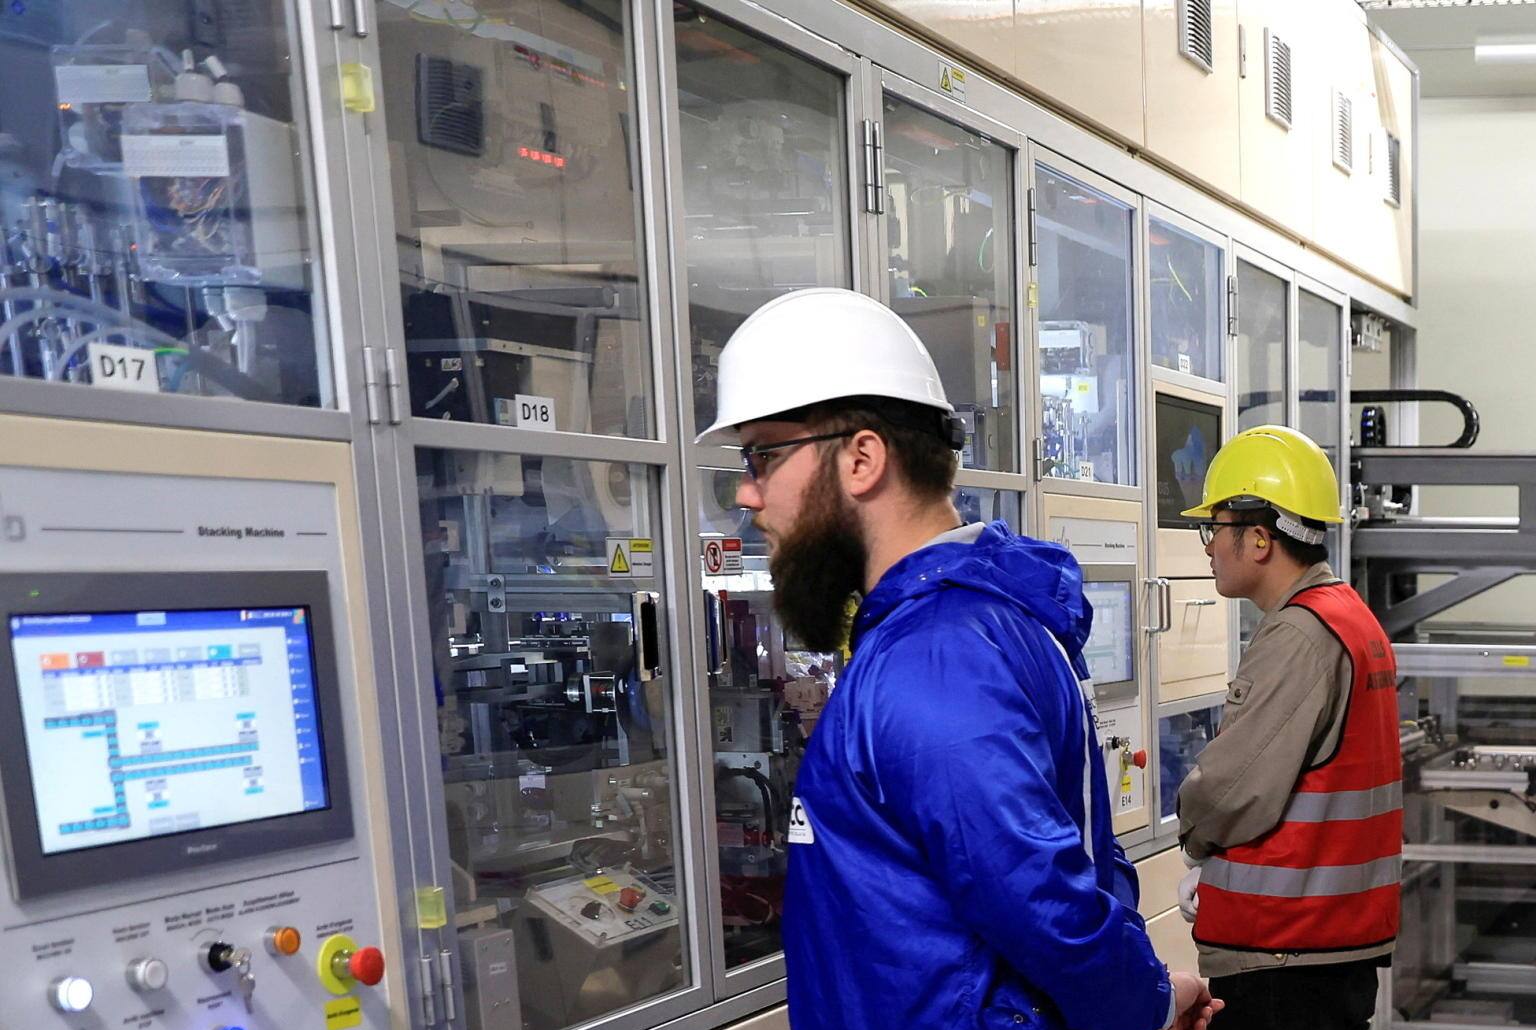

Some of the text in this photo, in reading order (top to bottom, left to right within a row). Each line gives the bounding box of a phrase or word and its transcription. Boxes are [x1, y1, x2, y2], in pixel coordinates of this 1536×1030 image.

[100, 354, 145, 381] D17
[522, 403, 549, 422] D18
[198, 526, 285, 539] Stacking Machine
